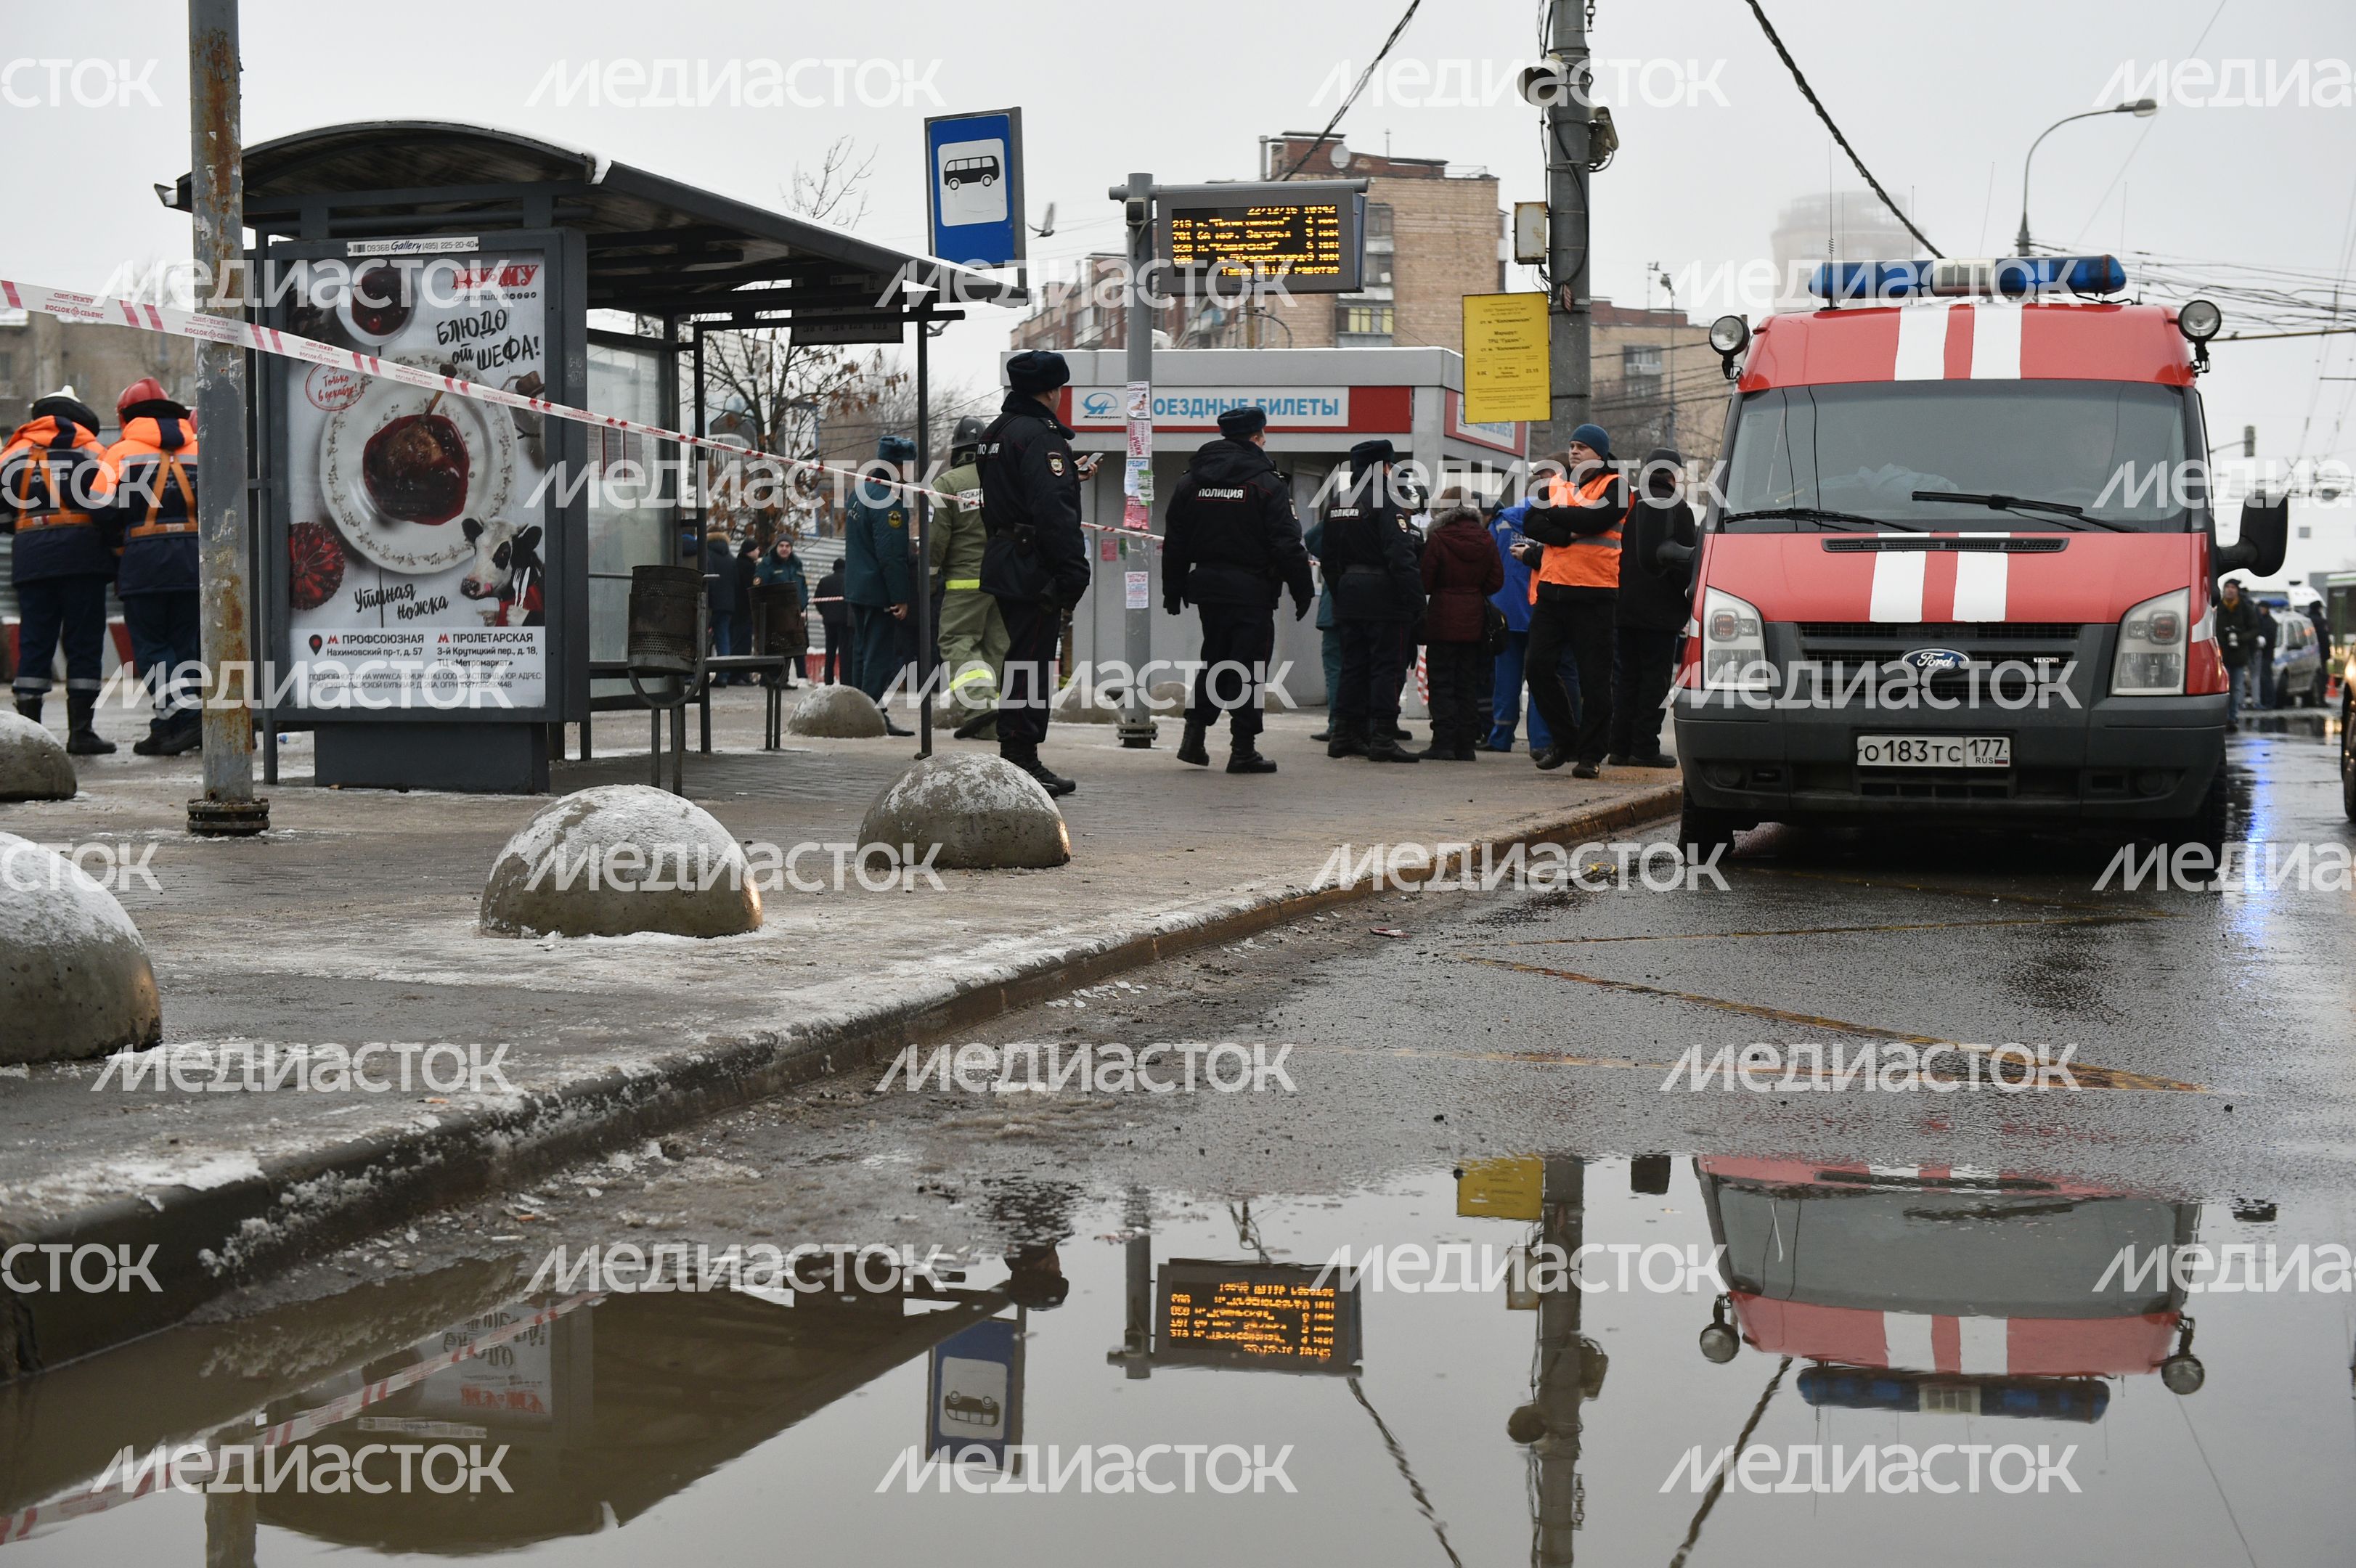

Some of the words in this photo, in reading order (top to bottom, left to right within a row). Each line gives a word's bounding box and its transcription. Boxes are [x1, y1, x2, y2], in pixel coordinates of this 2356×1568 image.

[391, 240, 423, 253] Gallery
[436, 309, 508, 346] БЛЮДО
[452, 343, 475, 364] от
[476, 334, 540, 371] ШЕФА!
[322, 375, 350, 388] Только
[318, 390, 324, 402] в
[324, 383, 358, 402] декабре!
[1153, 398, 1249, 418] ОЕЗДНЫЕ
[1255, 398, 1340, 416] БИЛЕТЫ
[1198, 488, 1244, 499] ПОЛИЦИЯ
[1329, 507, 1360, 519] ПОЛИЦИЯ
[354, 582, 417, 614] Утиная
[343, 634, 425, 645] ПРОФСОЮЗНАЯ
[453, 632, 534, 643] ПРОЛЕТАРСКАЯ
[327, 648, 382, 657] Нахимовский
[383, 649, 402, 658] пр-т,
[437, 647, 451, 656] 3-й
[452, 646, 496, 657] Крутицкий
[497, 648, 515, 656] пер.,
[517, 648, 525, 656] д.
[527, 646, 538, 656] 18,
[438, 659, 449, 668] ТЦ
[451, 658, 513, 669] «Метромаркет»
[1916, 651, 1954, 668] Ford
[1968, 739, 2004, 756] 177
